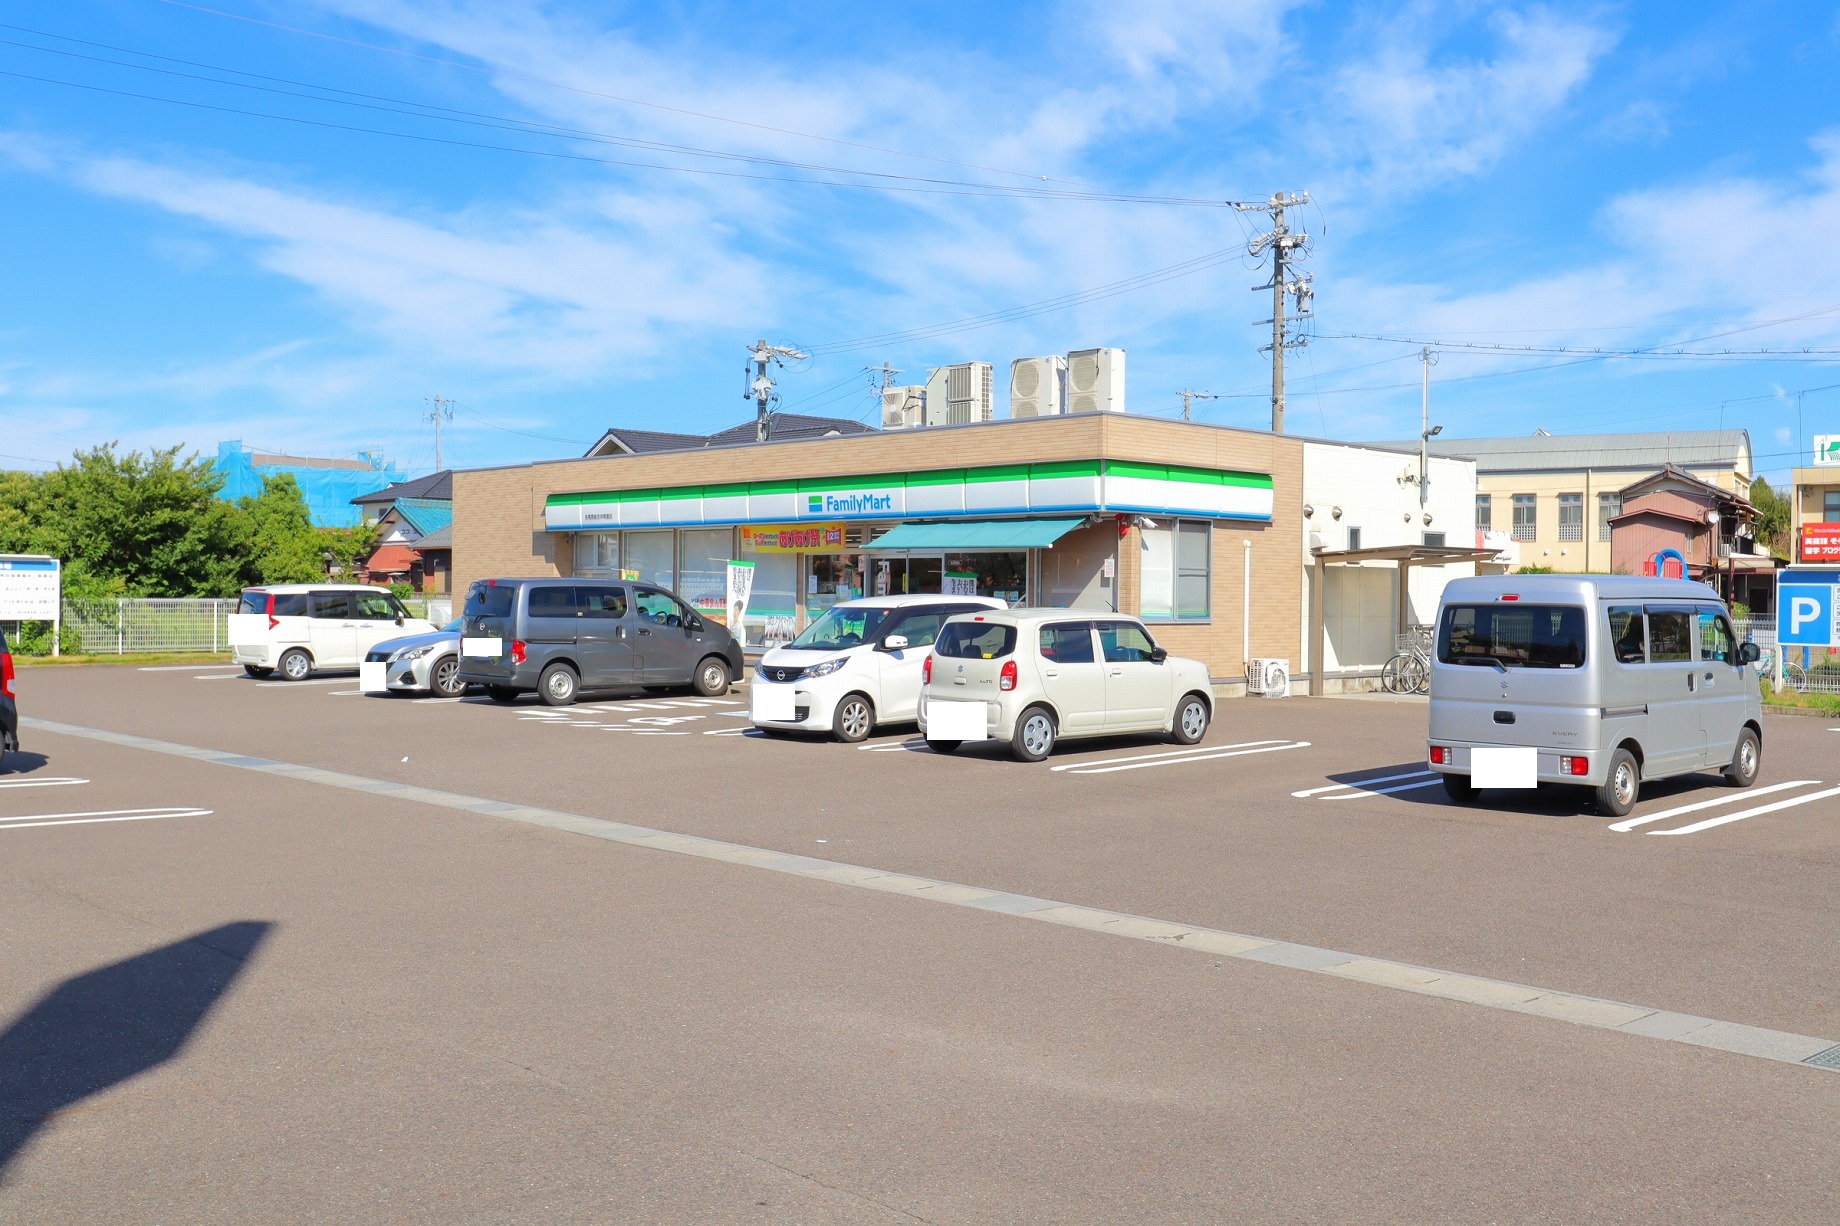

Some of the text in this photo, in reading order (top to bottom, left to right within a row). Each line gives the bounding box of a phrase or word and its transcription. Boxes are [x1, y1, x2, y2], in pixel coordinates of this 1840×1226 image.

[826, 493, 891, 514] FamilyMart
[779, 529, 820, 547] あげあげ祭
[1804, 537, 1840, 545] 英会話 そ
[1791, 597, 1821, 634] P
